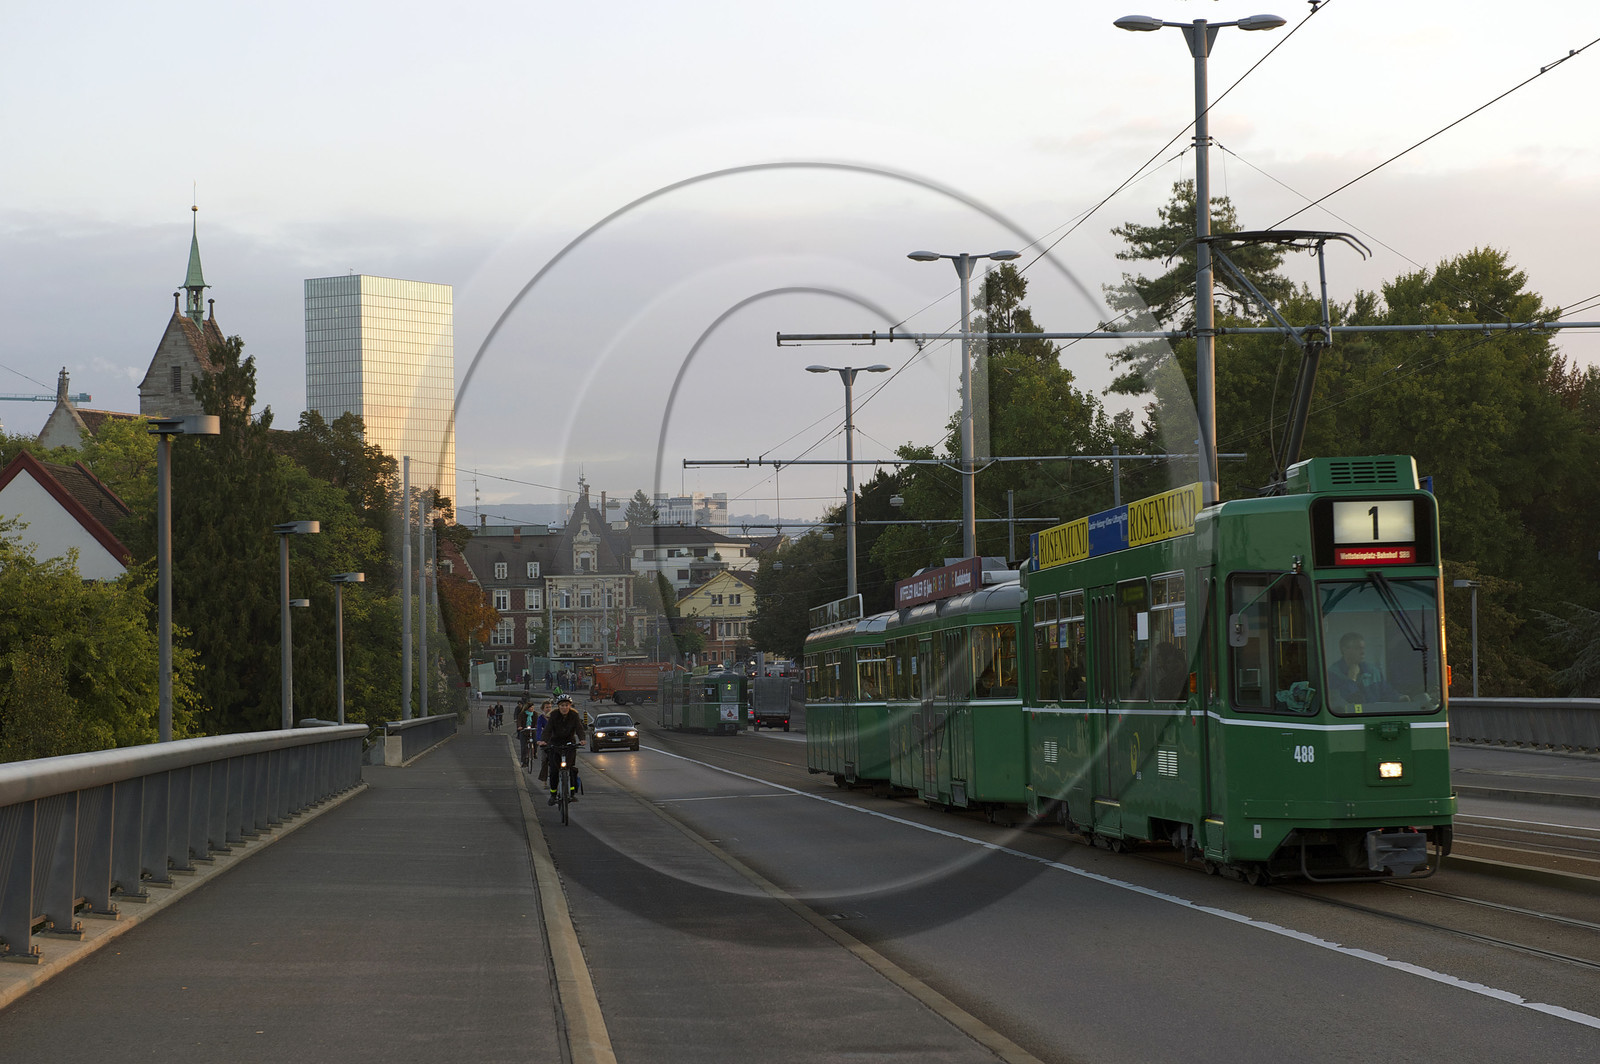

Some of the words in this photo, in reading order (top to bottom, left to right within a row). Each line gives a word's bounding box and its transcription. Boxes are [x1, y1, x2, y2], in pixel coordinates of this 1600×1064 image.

[1129, 489, 1196, 542] ROSENMUND
[1368, 506, 1379, 540] 1
[1039, 521, 1088, 565] ROSENMUND
[1294, 745, 1315, 763] 488
